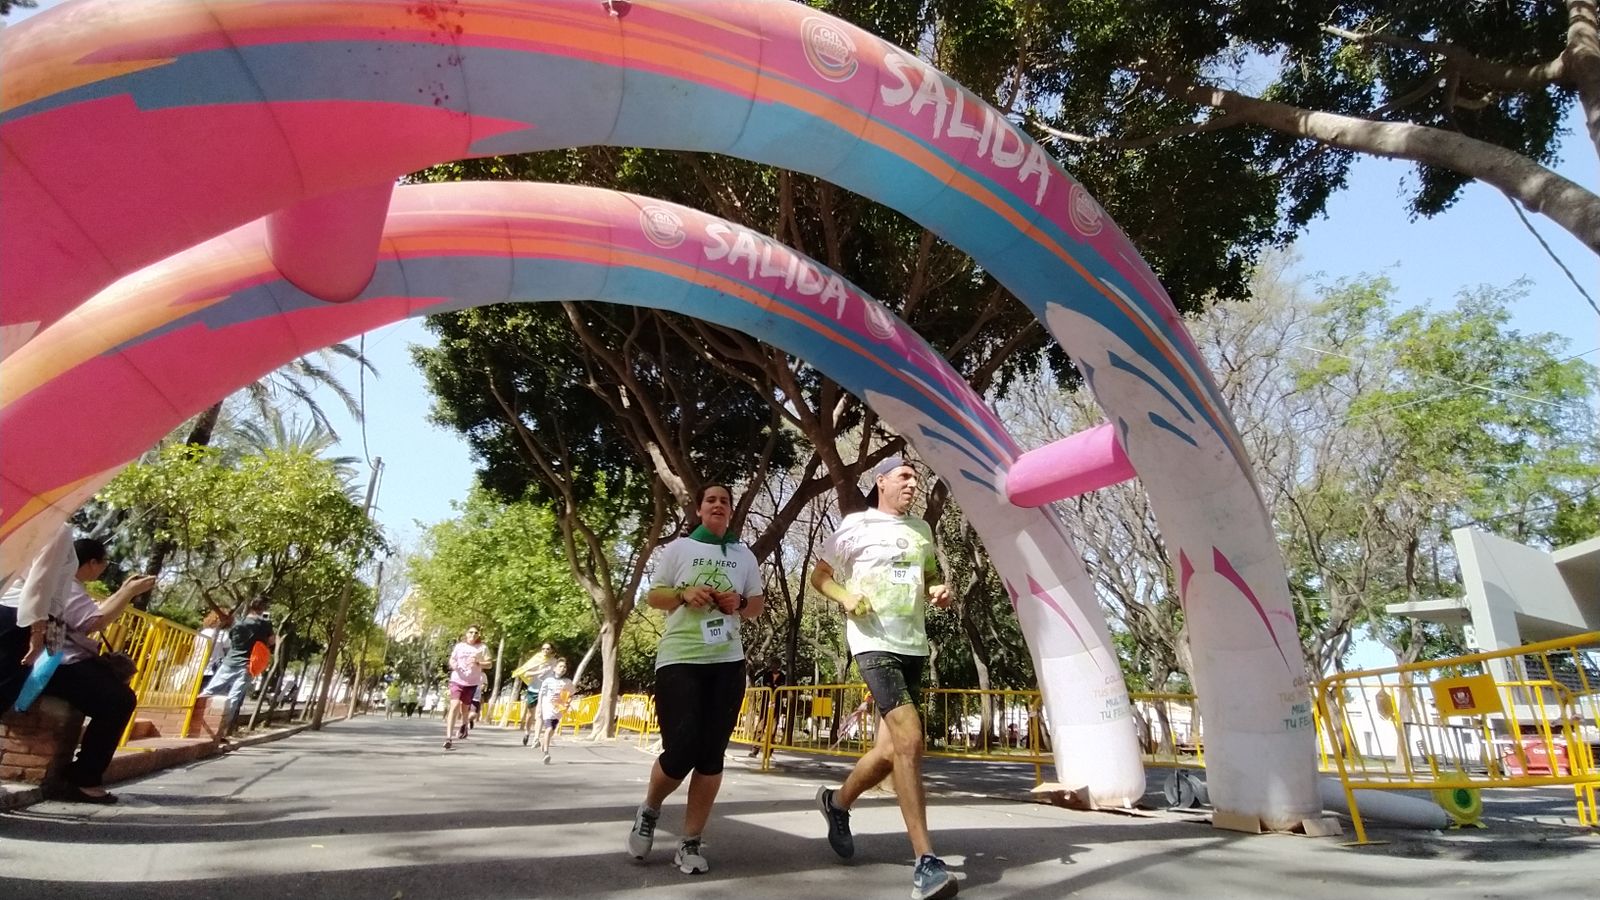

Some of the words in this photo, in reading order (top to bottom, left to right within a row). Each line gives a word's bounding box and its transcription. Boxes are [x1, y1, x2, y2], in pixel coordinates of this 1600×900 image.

[879, 52, 1053, 206] SALIDA
[703, 222, 849, 320] SALIDA
[692, 558, 705, 568] BE
[706, 558, 713, 567] A
[715, 559, 737, 570] HERO
[894, 570, 907, 580] 167
[709, 627, 722, 637] 101
[1099, 711, 1111, 721] TU
[1283, 719, 1296, 730] TU
